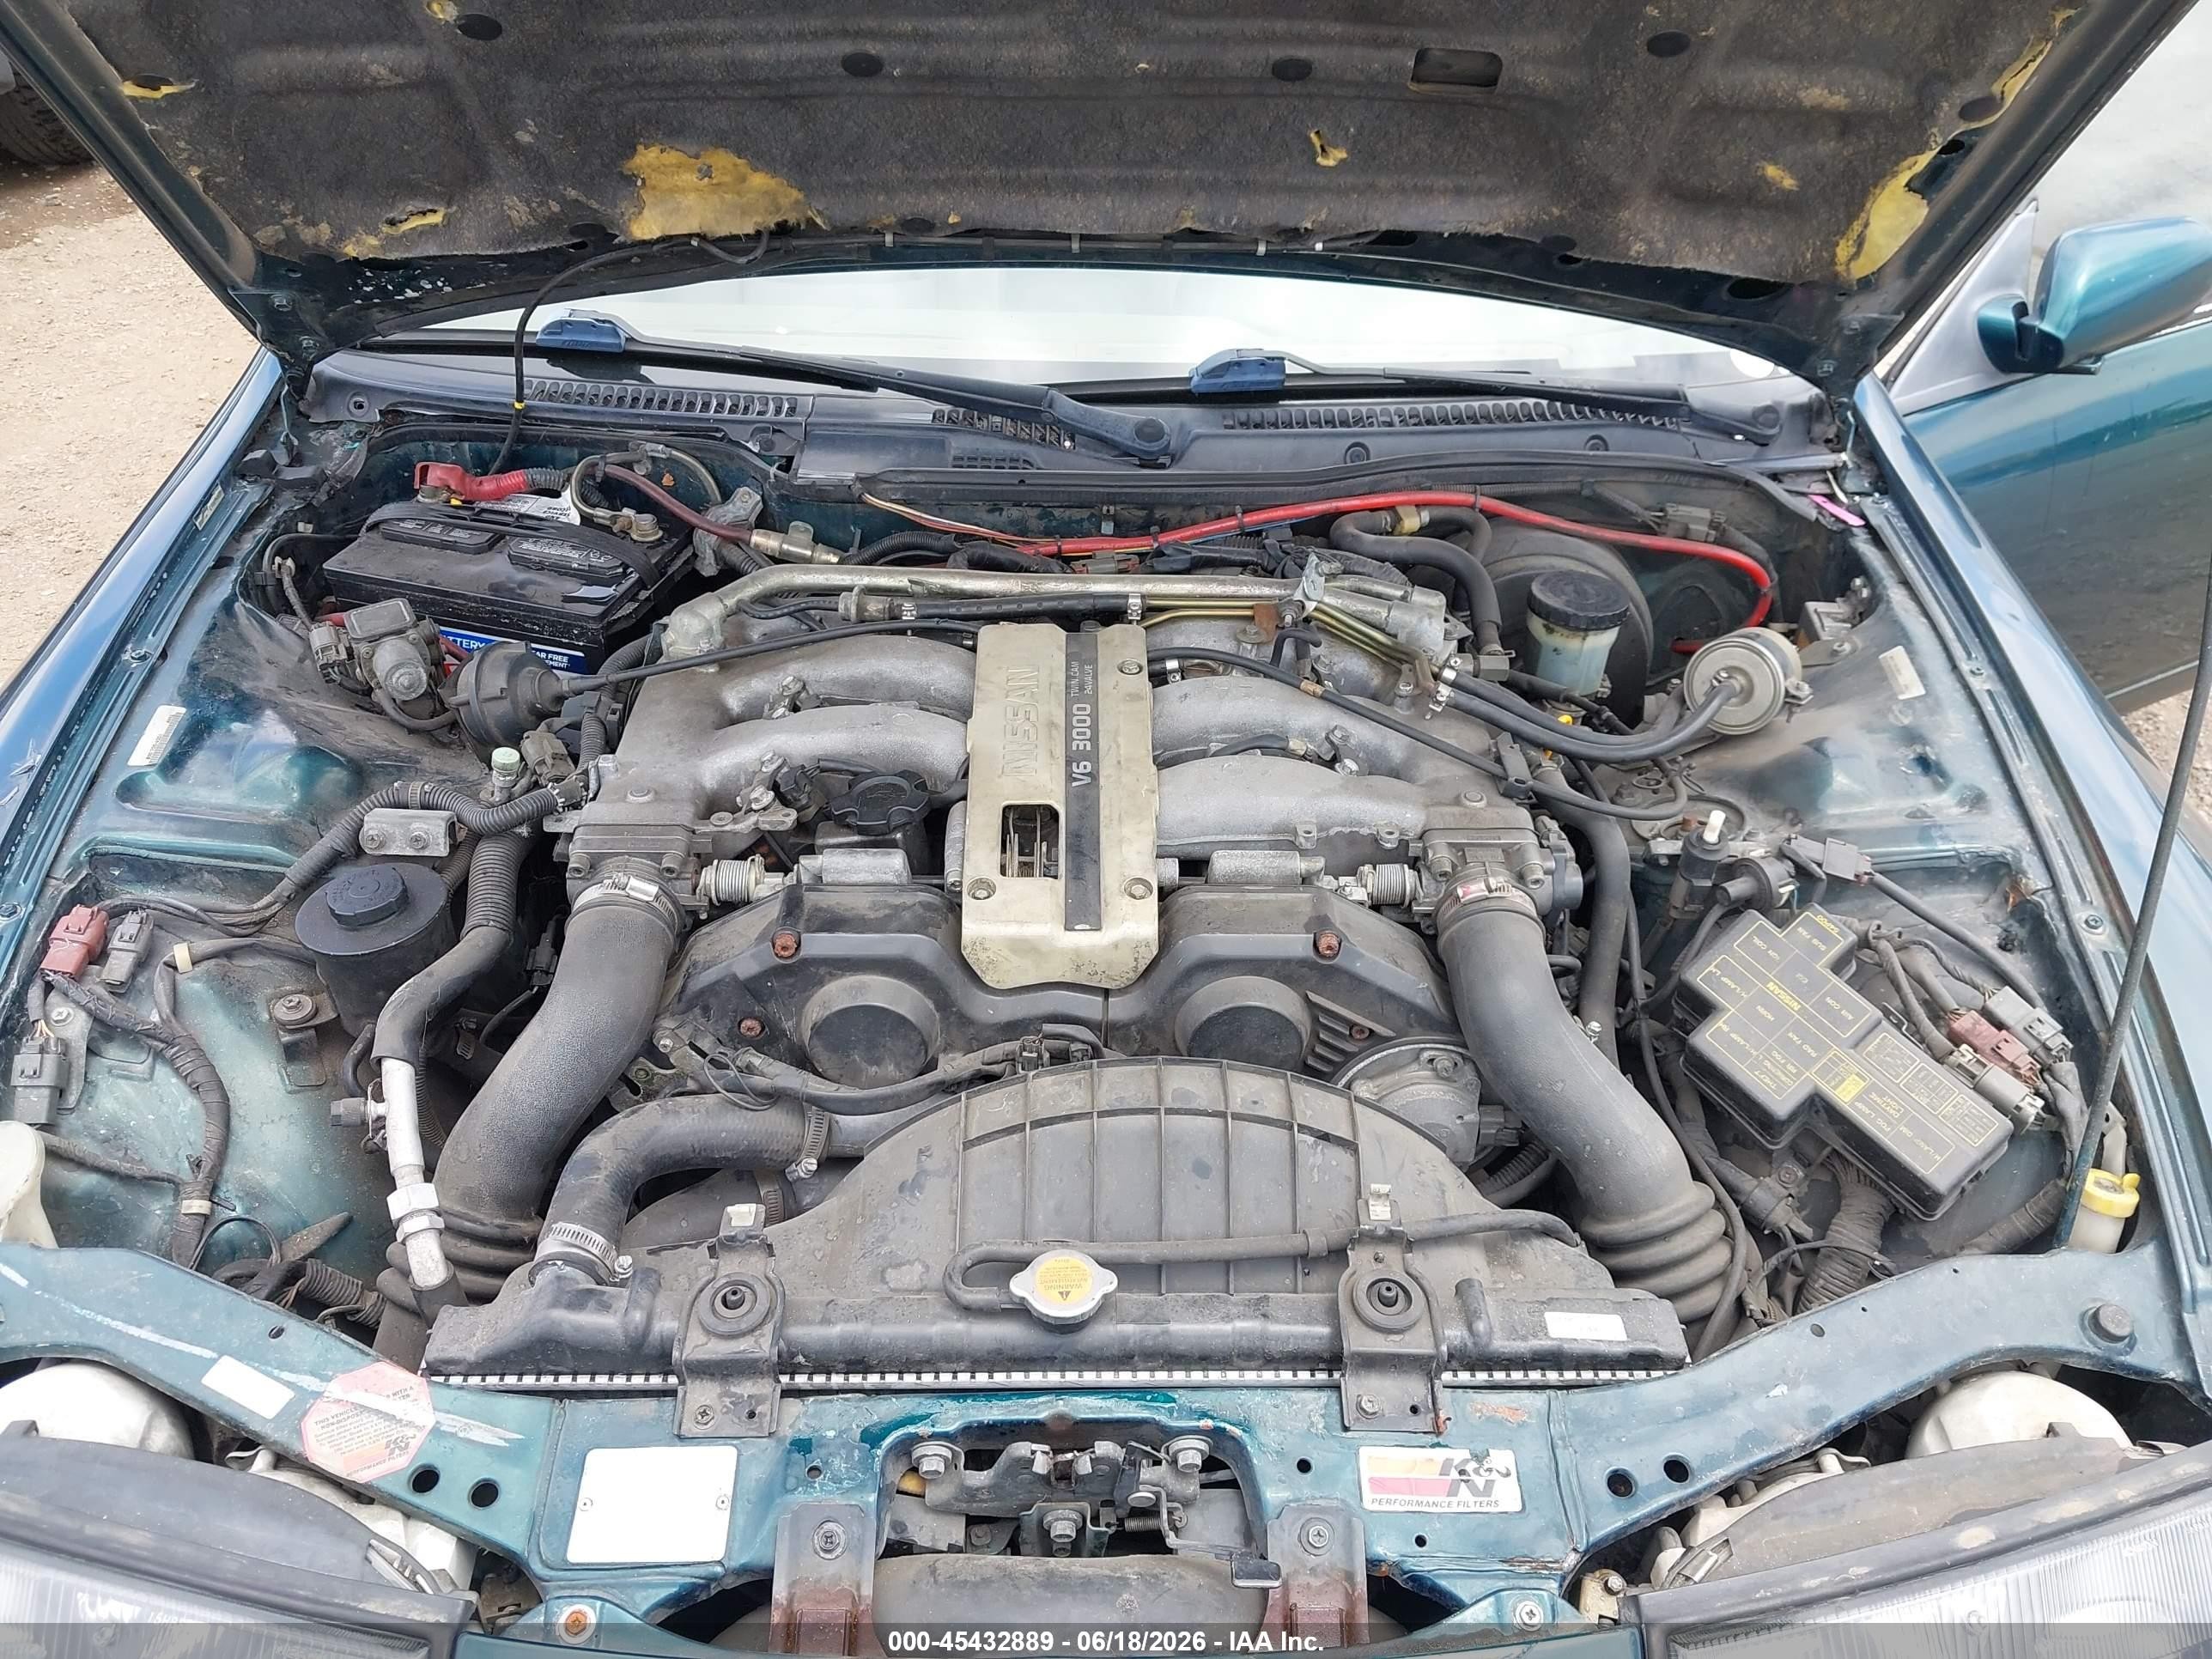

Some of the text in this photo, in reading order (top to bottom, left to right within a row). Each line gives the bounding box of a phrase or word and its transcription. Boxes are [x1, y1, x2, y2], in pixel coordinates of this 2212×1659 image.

[548, 653, 569, 663] FREE
[1071, 661, 1079, 697] TWIN CAM
[1001, 665, 1040, 777] NISSAN
[1071, 703, 1092, 787] V6 3000
[1765, 981, 1801, 1012] NISSAN
[1755, 1004, 1775, 1022] HORN
[1370, 1498, 1499, 1509] PERFORMANCE FILTERS
